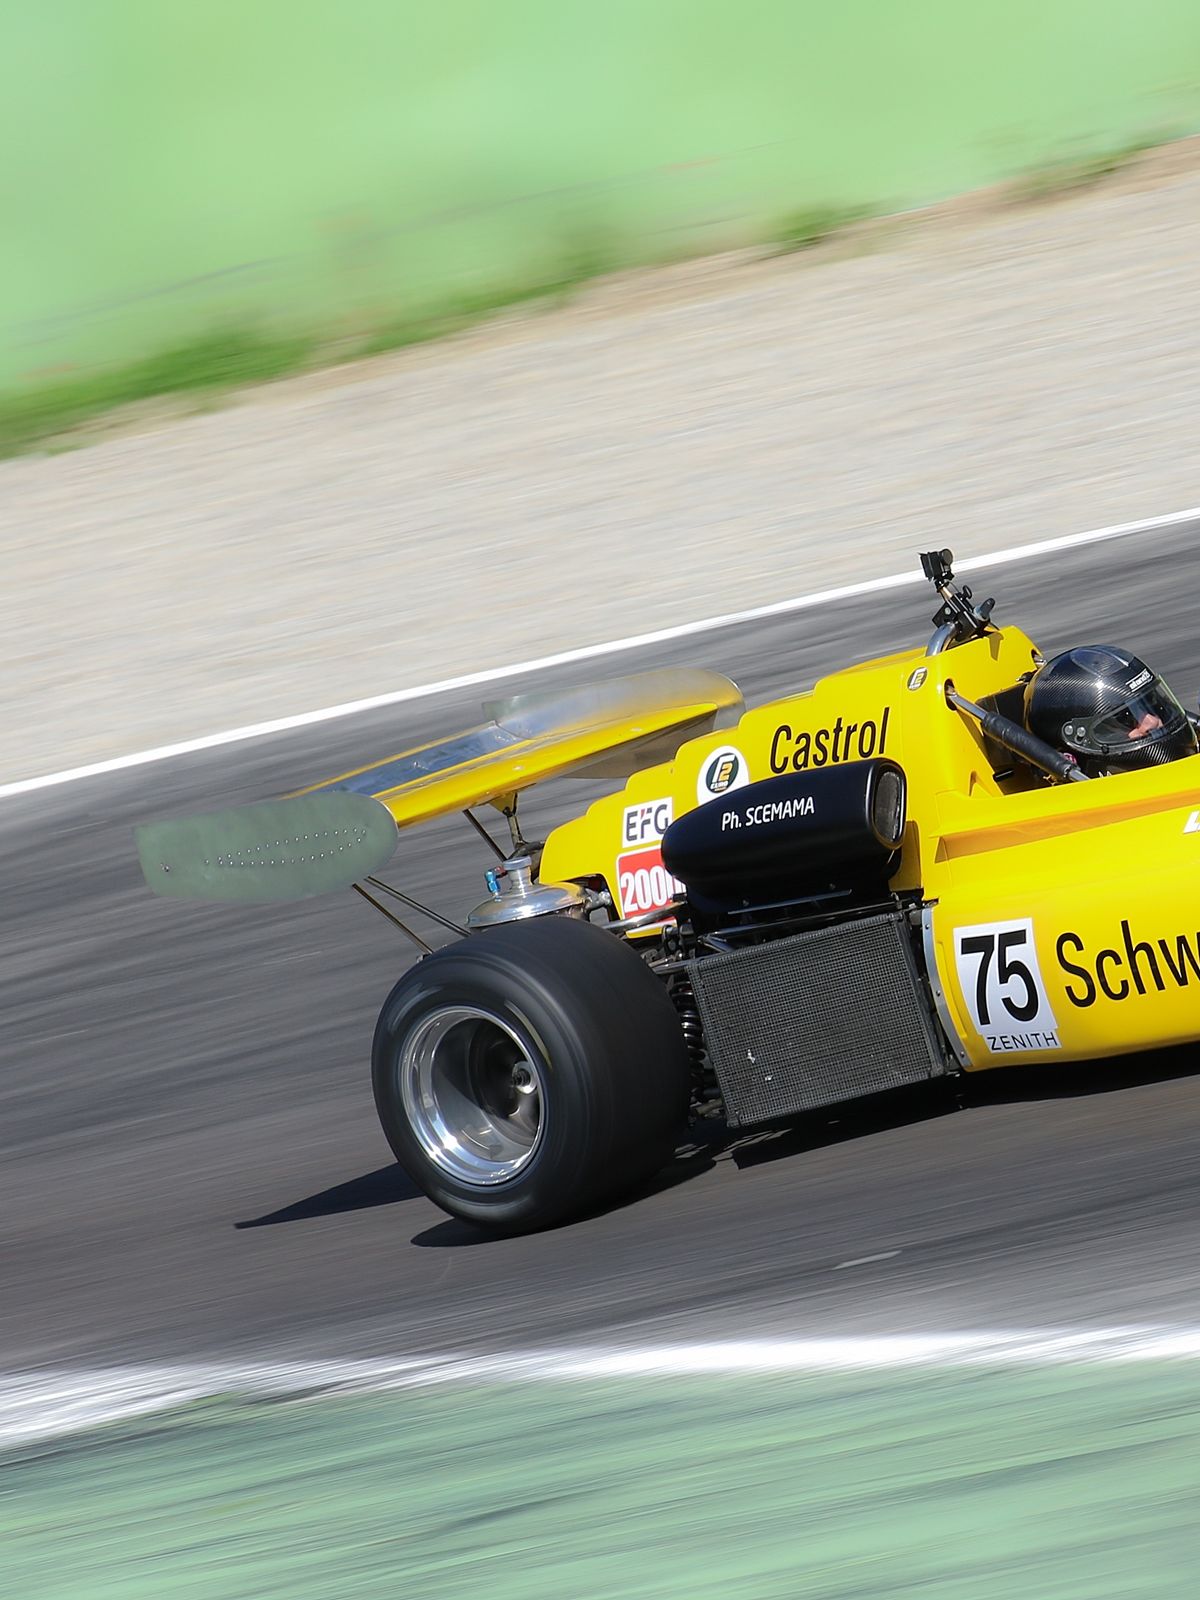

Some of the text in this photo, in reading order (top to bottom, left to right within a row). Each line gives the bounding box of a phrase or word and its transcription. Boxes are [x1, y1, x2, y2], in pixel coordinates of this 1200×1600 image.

[770, 706, 890, 774] Castrol
[626, 804, 669, 841] EFG
[722, 796, 815, 831] Ph. SCEMAMA
[961, 929, 1039, 1026] 75
[987, 1032, 1057, 1051] ZENITH
